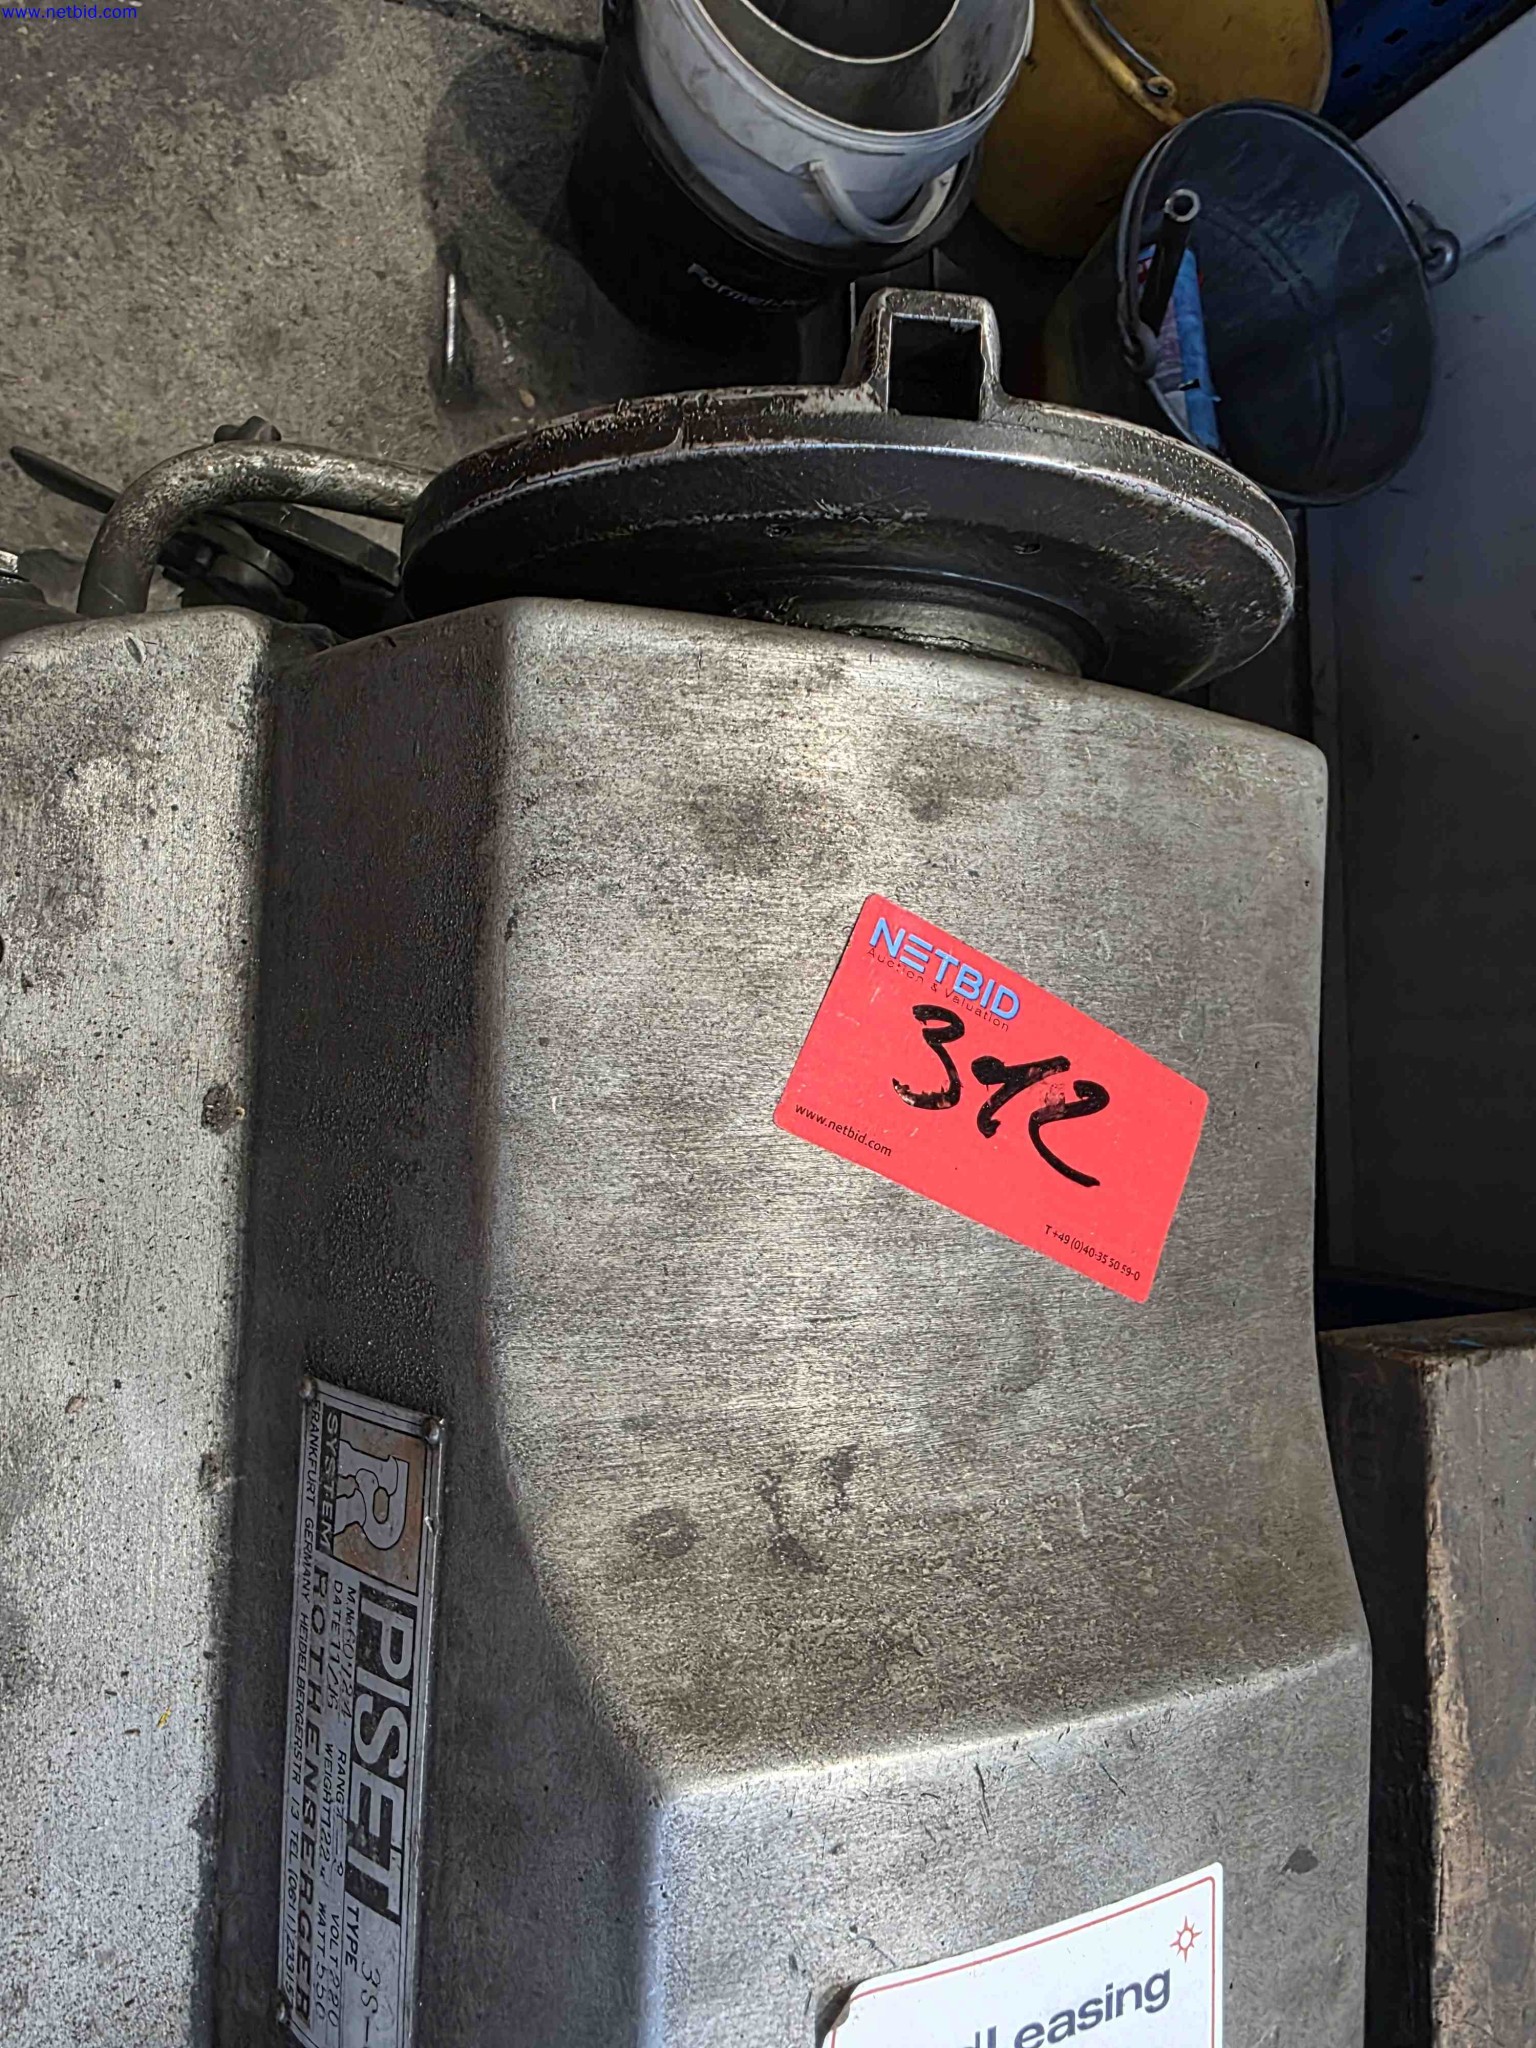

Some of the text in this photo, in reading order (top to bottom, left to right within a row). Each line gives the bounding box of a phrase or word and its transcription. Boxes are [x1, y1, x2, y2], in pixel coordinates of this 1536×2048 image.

[867, 948, 1009, 1032] Auction & Valuation
[869, 917, 1021, 1021] NETBID
[795, 1104, 892, 1157] www.netbid.com
[1045, 1224, 1052, 1235] T
[1053, 1230, 1071, 1245] +49
[1108, 1258, 1120, 1270] 50
[1120, 1264, 1141, 1281] 59-0
[304, 1400, 321, 1507] FRANKFURT
[316, 1411, 339, 1553] SYSTEM
[299, 1516, 315, 1604] GERMANY
[329, 1579, 343, 1637] DATE
[291, 1611, 310, 1786] HEIDELBERGERSTR
[347, 1597, 415, 1916] PISET
[288, 1796, 300, 1820] 13
[295, 1563, 329, 2021] ROTHENBERGER
[287, 1829, 299, 1866] TEL
[316, 1901, 328, 1957] WATT
[328, 1913, 340, 1968] VOLT
[345, 1905, 360, 1973] TYPE
[315, 1960, 328, 2021] 550
